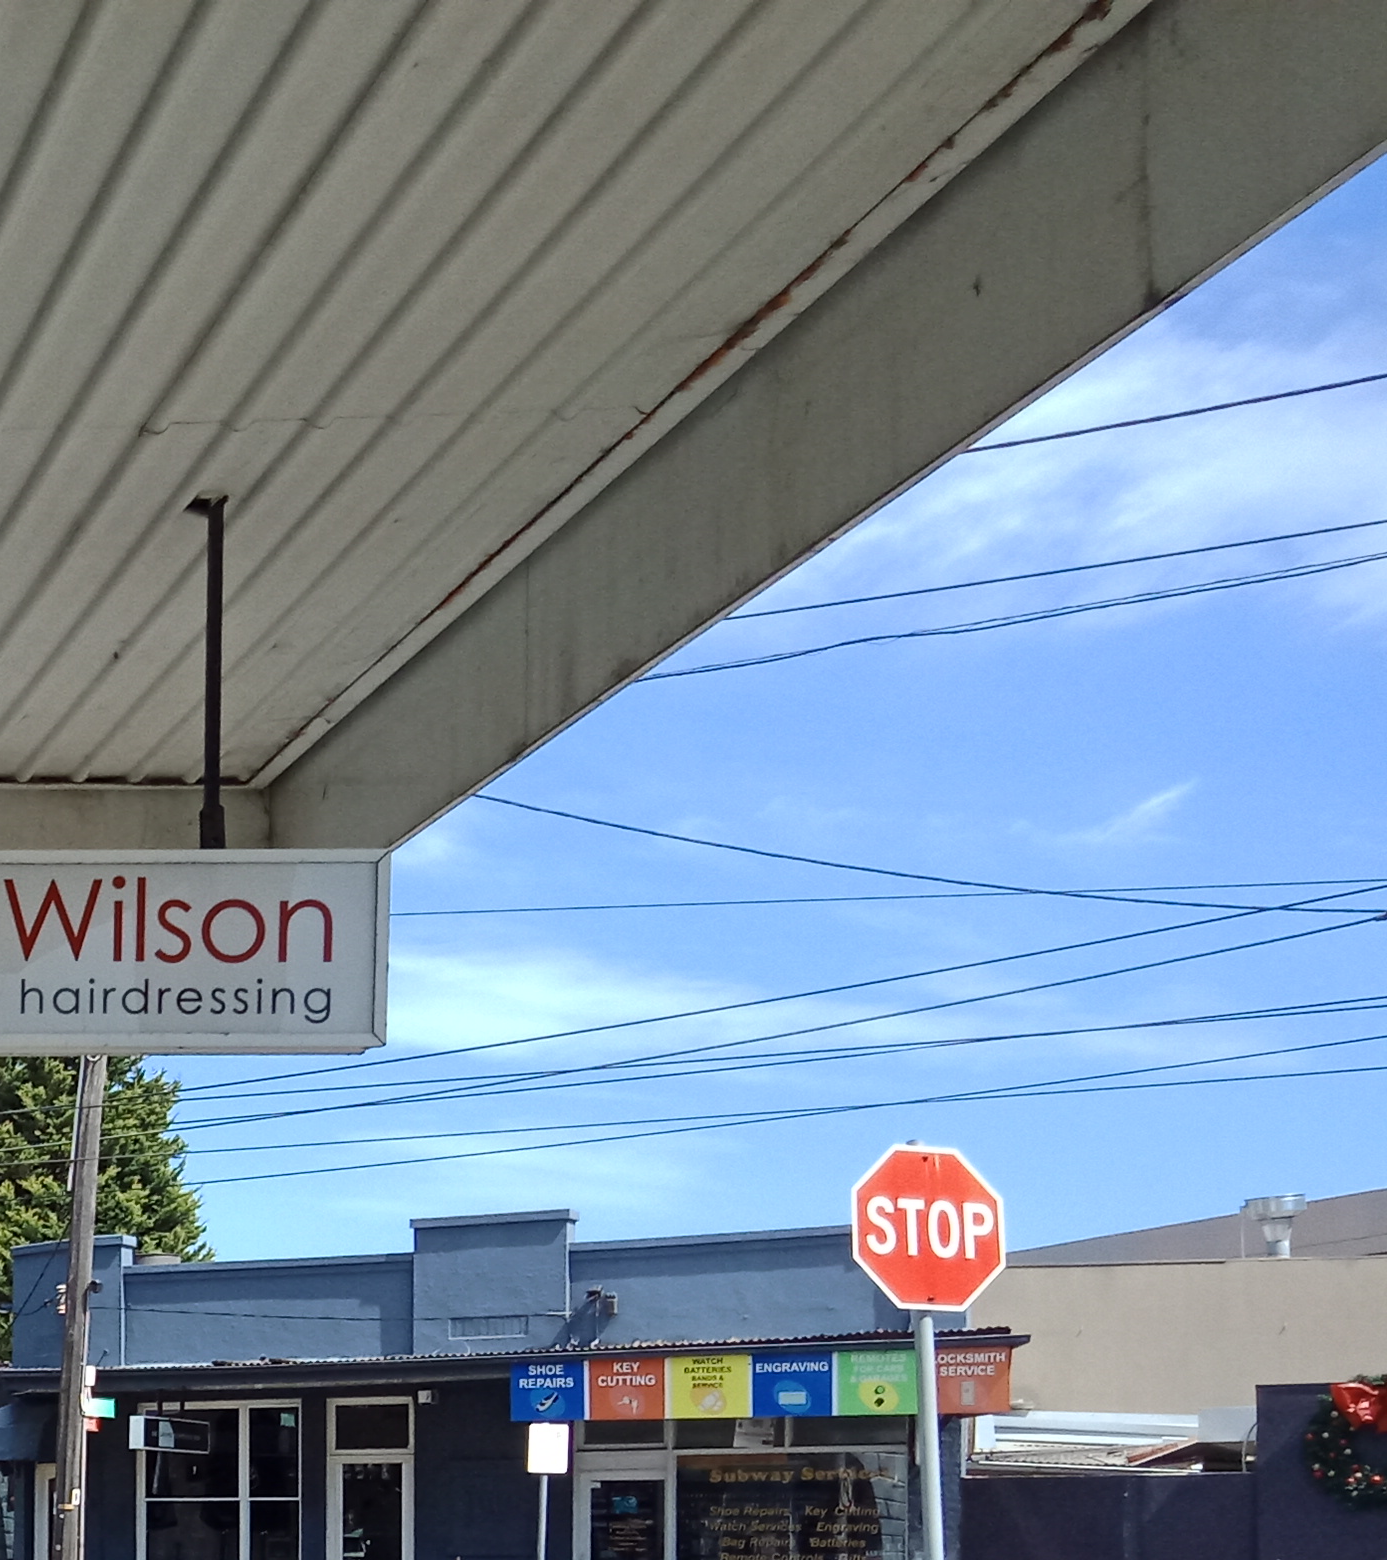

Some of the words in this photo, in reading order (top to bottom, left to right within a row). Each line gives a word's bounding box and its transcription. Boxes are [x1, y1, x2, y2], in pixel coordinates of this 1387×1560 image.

[3, 876, 334, 964] Wilson
[19, 978, 334, 1024] hairdressing
[865, 1195, 995, 1260] STOP
[691, 1357, 724, 1365] WATCH
[849, 1353, 907, 1364] REMOTES
[528, 1364, 565, 1376] SHOE
[613, 1361, 640, 1373] KEY
[683, 1365, 732, 1374] BATTERIES
[755, 1361, 829, 1373] ENGRAVING
[853, 1364, 876, 1373] FOR
[877, 1364, 905, 1373] CARS
[939, 1365, 995, 1377] SERVICE
[518, 1377, 574, 1389] REPAIRS
[597, 1375, 656, 1387] CUTTING
[858, 1373, 908, 1384] GARAGES
[709, 1469, 794, 1483] Subway
[805, 1505, 827, 1518] Key
[816, 1521, 879, 1534] Engraving
